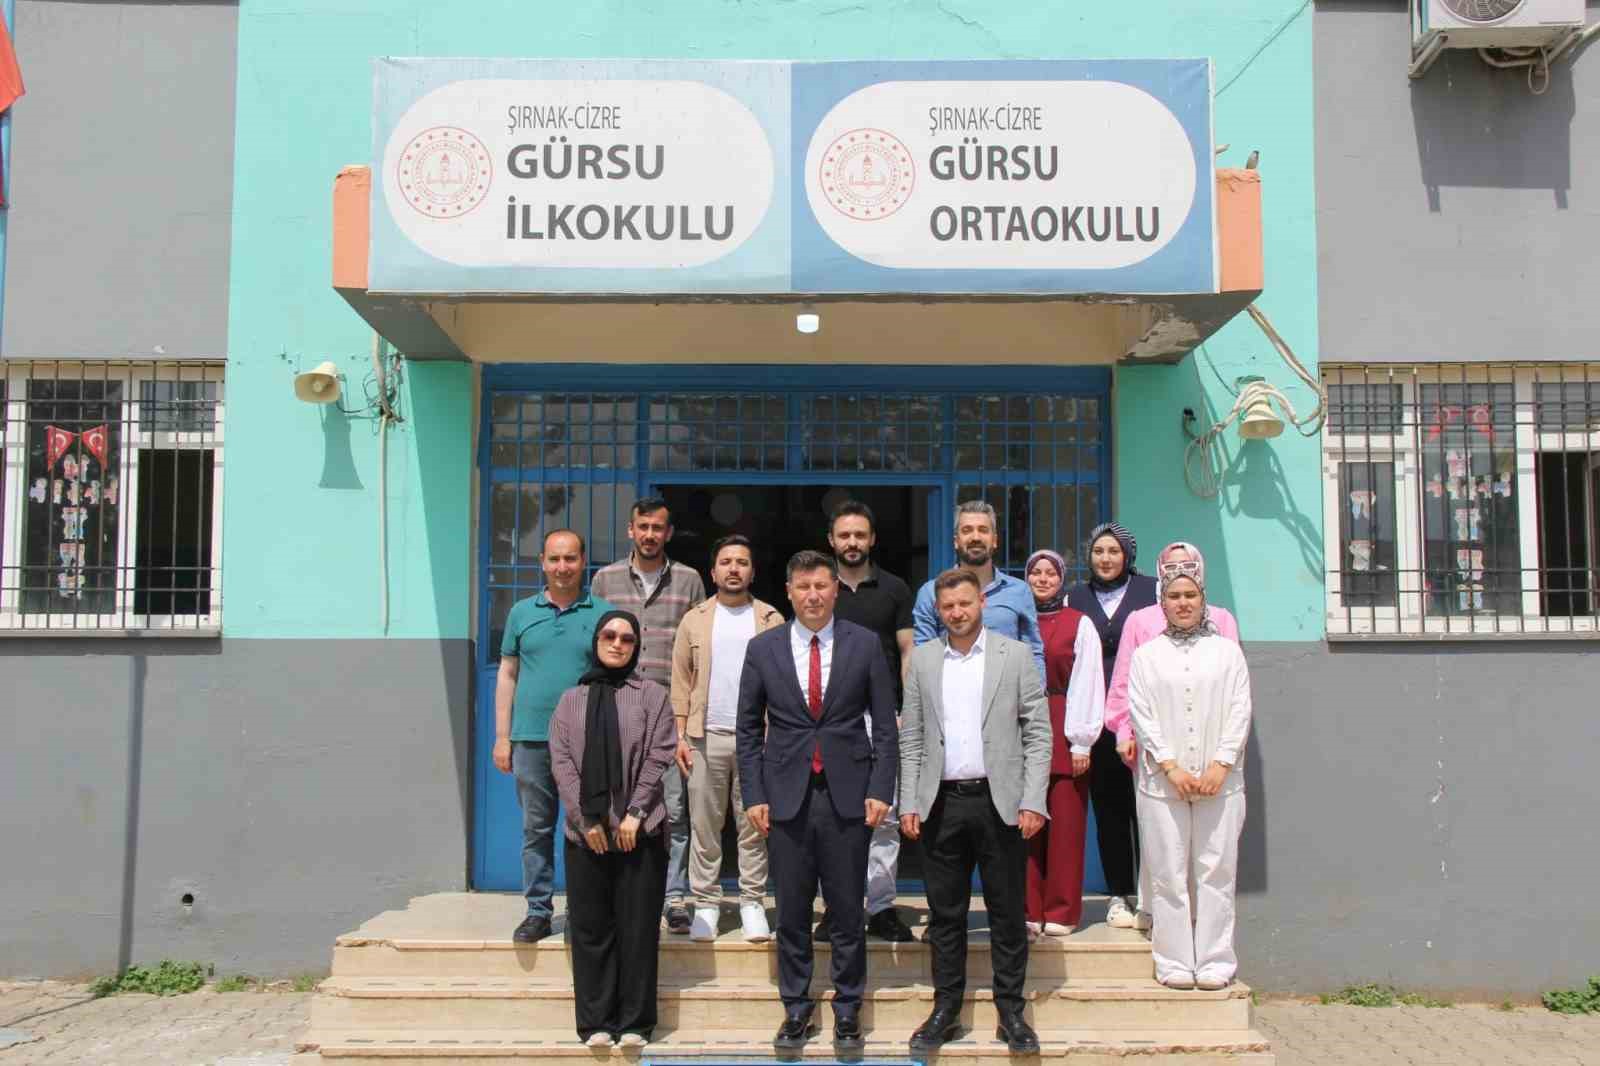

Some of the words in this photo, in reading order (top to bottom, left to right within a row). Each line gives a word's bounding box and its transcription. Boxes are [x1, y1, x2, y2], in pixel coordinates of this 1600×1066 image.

[508, 102, 621, 134] ŞIRNAK-CİZRE
[929, 103, 1043, 136] ŞIRNAK-CİZRE
[506, 135, 665, 180] GÜRSU
[929, 136, 1058, 181] GÜRSU
[506, 195, 734, 241] İLKOKULU
[929, 205, 1160, 243] ORTAOKULU
